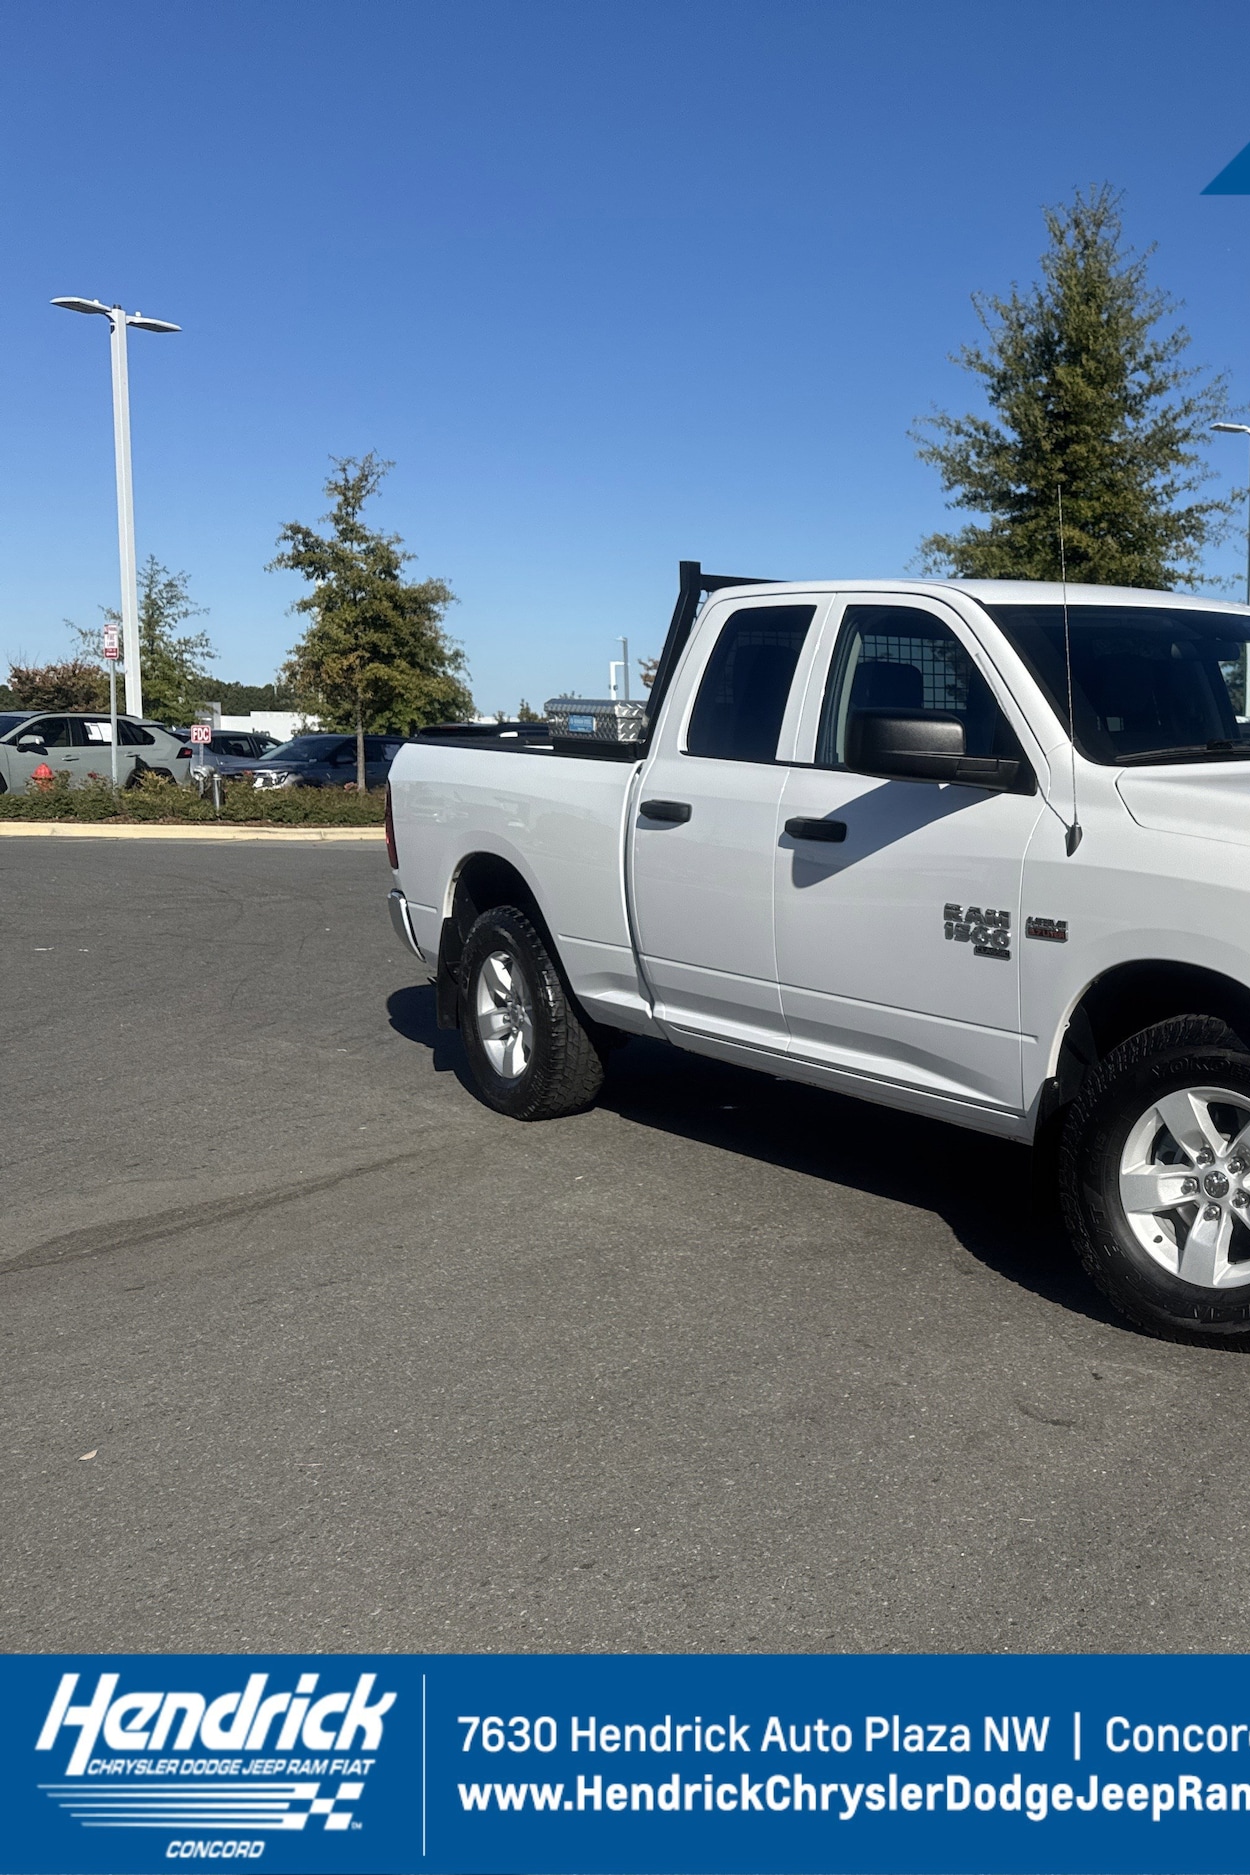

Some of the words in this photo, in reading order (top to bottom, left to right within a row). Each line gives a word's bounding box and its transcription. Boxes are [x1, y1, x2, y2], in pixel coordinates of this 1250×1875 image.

[192, 727, 209, 741] FDC
[943, 902, 1011, 930] RAM
[944, 921, 1012, 950] 1500
